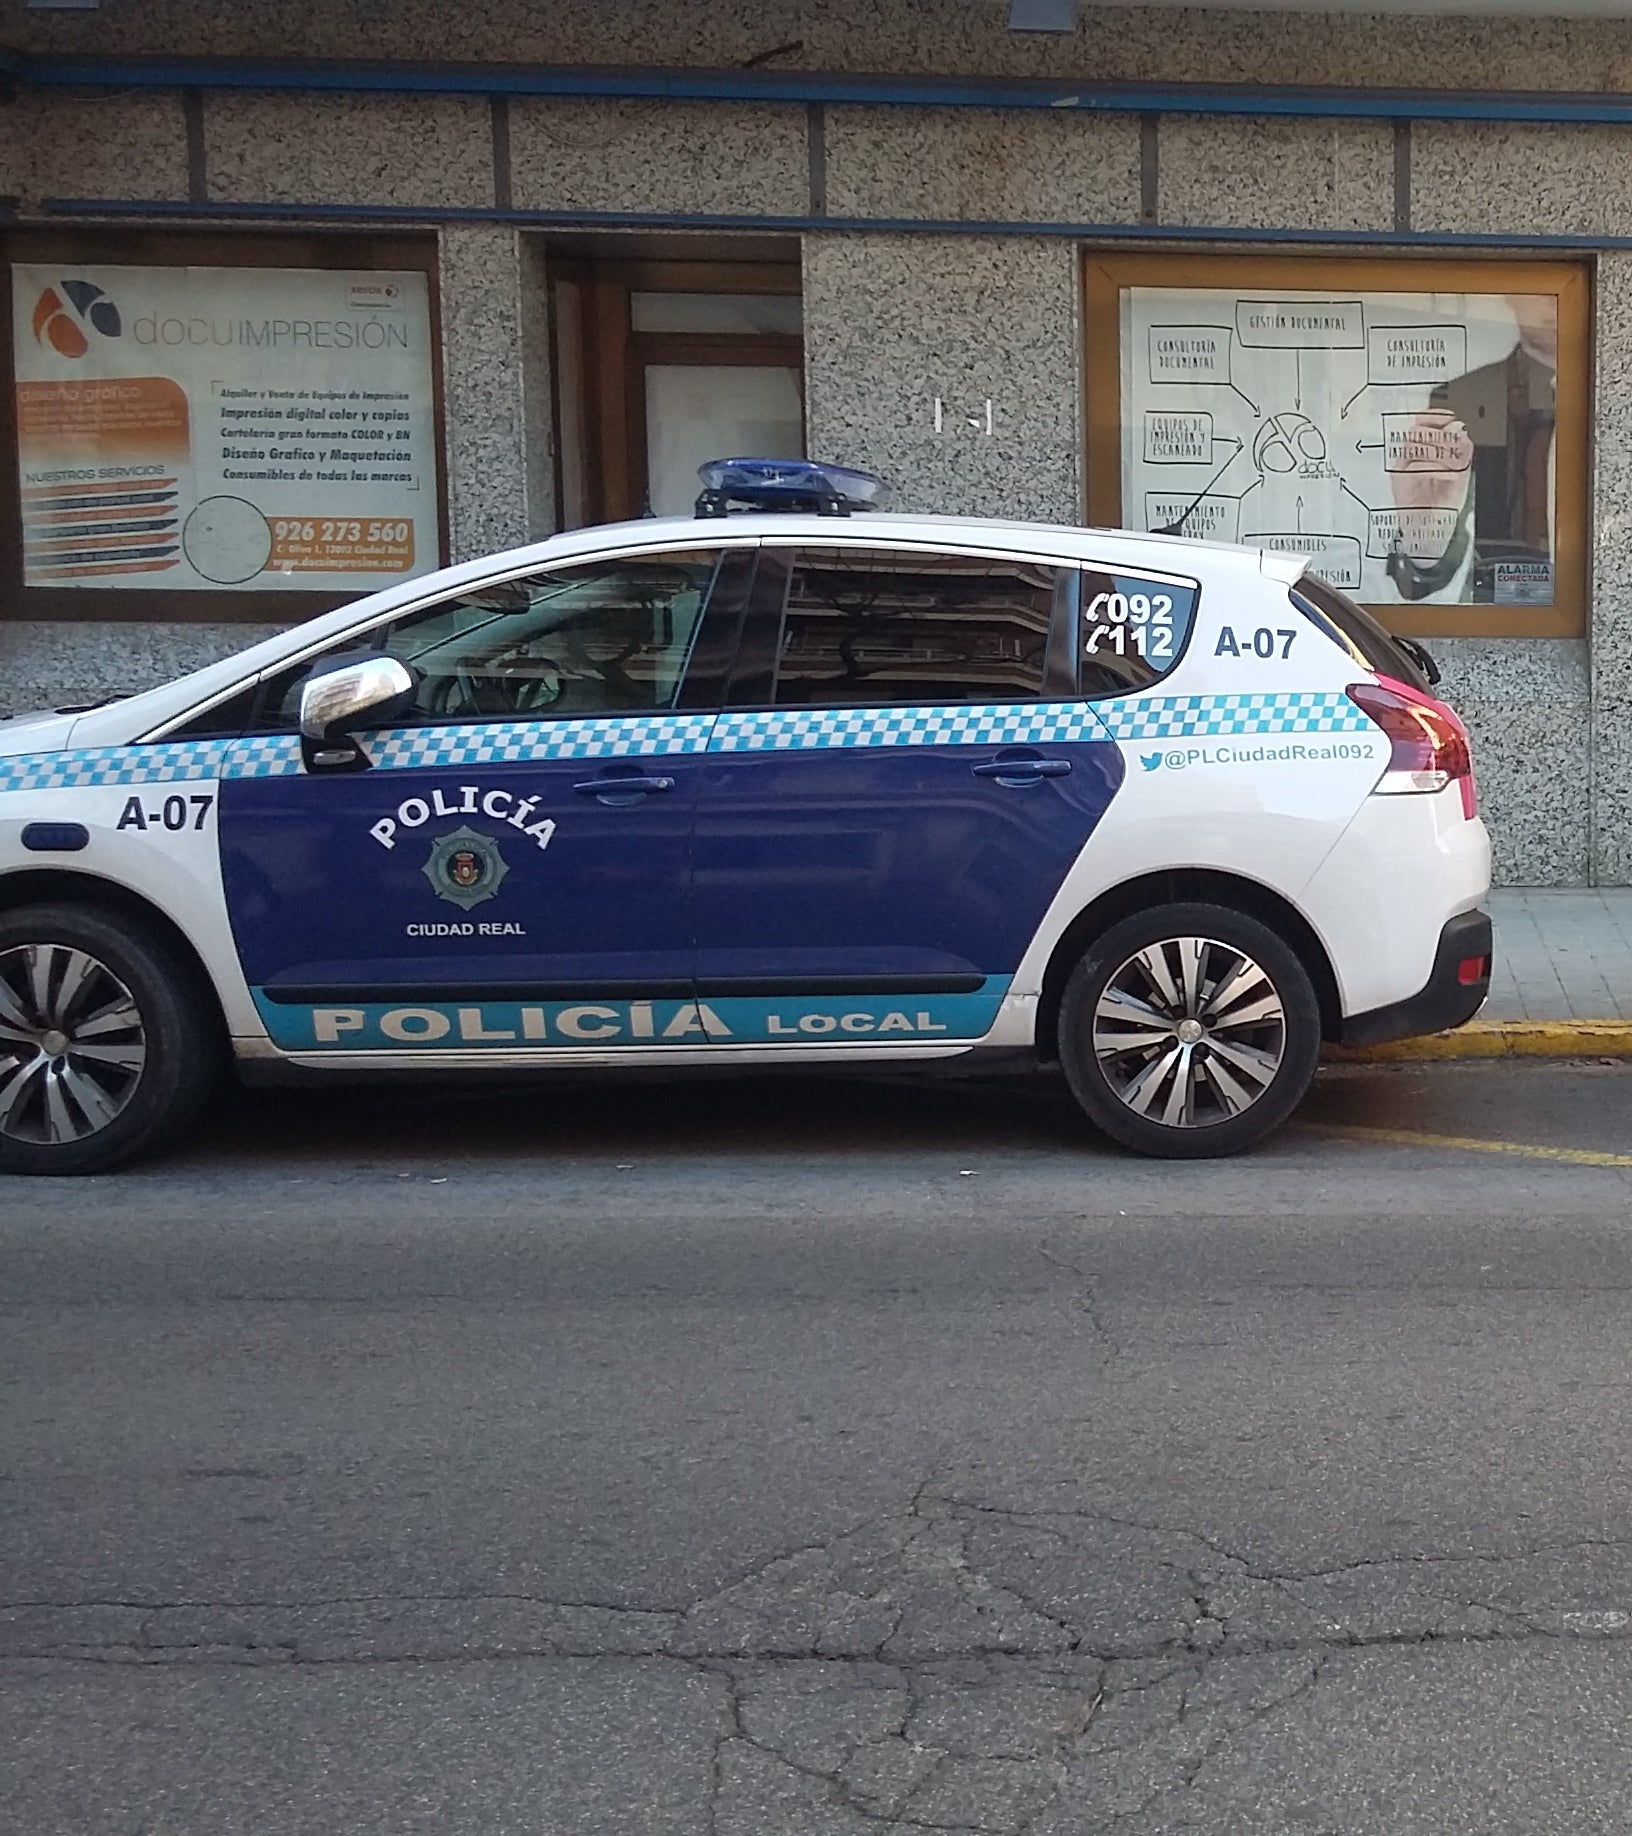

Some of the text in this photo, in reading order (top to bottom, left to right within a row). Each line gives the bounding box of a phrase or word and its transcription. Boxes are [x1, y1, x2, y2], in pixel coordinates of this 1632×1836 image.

[1250, 314, 1346, 331] GESTIÓN DOCUMENTAL
[1157, 339, 1216, 353] CONSULTORÍA
[1387, 338, 1445, 352] CONSULTORÍA
[1159, 356, 1215, 369] DOCUMENTAL
[1387, 354, 1446, 368] DE IMPRESIÓN
[298, 390, 310, 399] de
[348, 390, 360, 400] de
[286, 407, 326, 421] digital
[329, 409, 358, 420] color
[361, 411, 368, 422] y
[372, 410, 410, 422] copias
[1191, 418, 1203, 431] DE
[278, 431, 303, 441] gran
[305, 428, 348, 439] formato
[351, 430, 384, 440] COLOR
[395, 430, 411, 440] BN
[222, 446, 265, 460] Diseño
[319, 451, 325, 462] y
[1153, 443, 1202, 456] ESCANEADO
[1436, 447, 1444, 459] DE
[25, 464, 165, 483] NUESTROS SERVICIOS
[223, 468, 412, 482] Consumibles de todas las marcas
[1186, 518, 1216, 530] QUIPOS
[275, 521, 408, 542] 926 273 560
[1269, 538, 1327, 551] CONSUMIBLES
[1497, 565, 1550, 575] ALARMA
[1107, 593, 1174, 625] 092
[1107, 626, 1174, 657] 112
[1213, 625, 1298, 660] A-07
[1164, 743, 1375, 771] @PLCiudadReal092
[116, 794, 214, 831] A-07
[369, 785, 557, 850] POLICÍA
[407, 922, 526, 936] CIUDAD REAL
[313, 1000, 947, 1041] POLICÍA LOCAL
